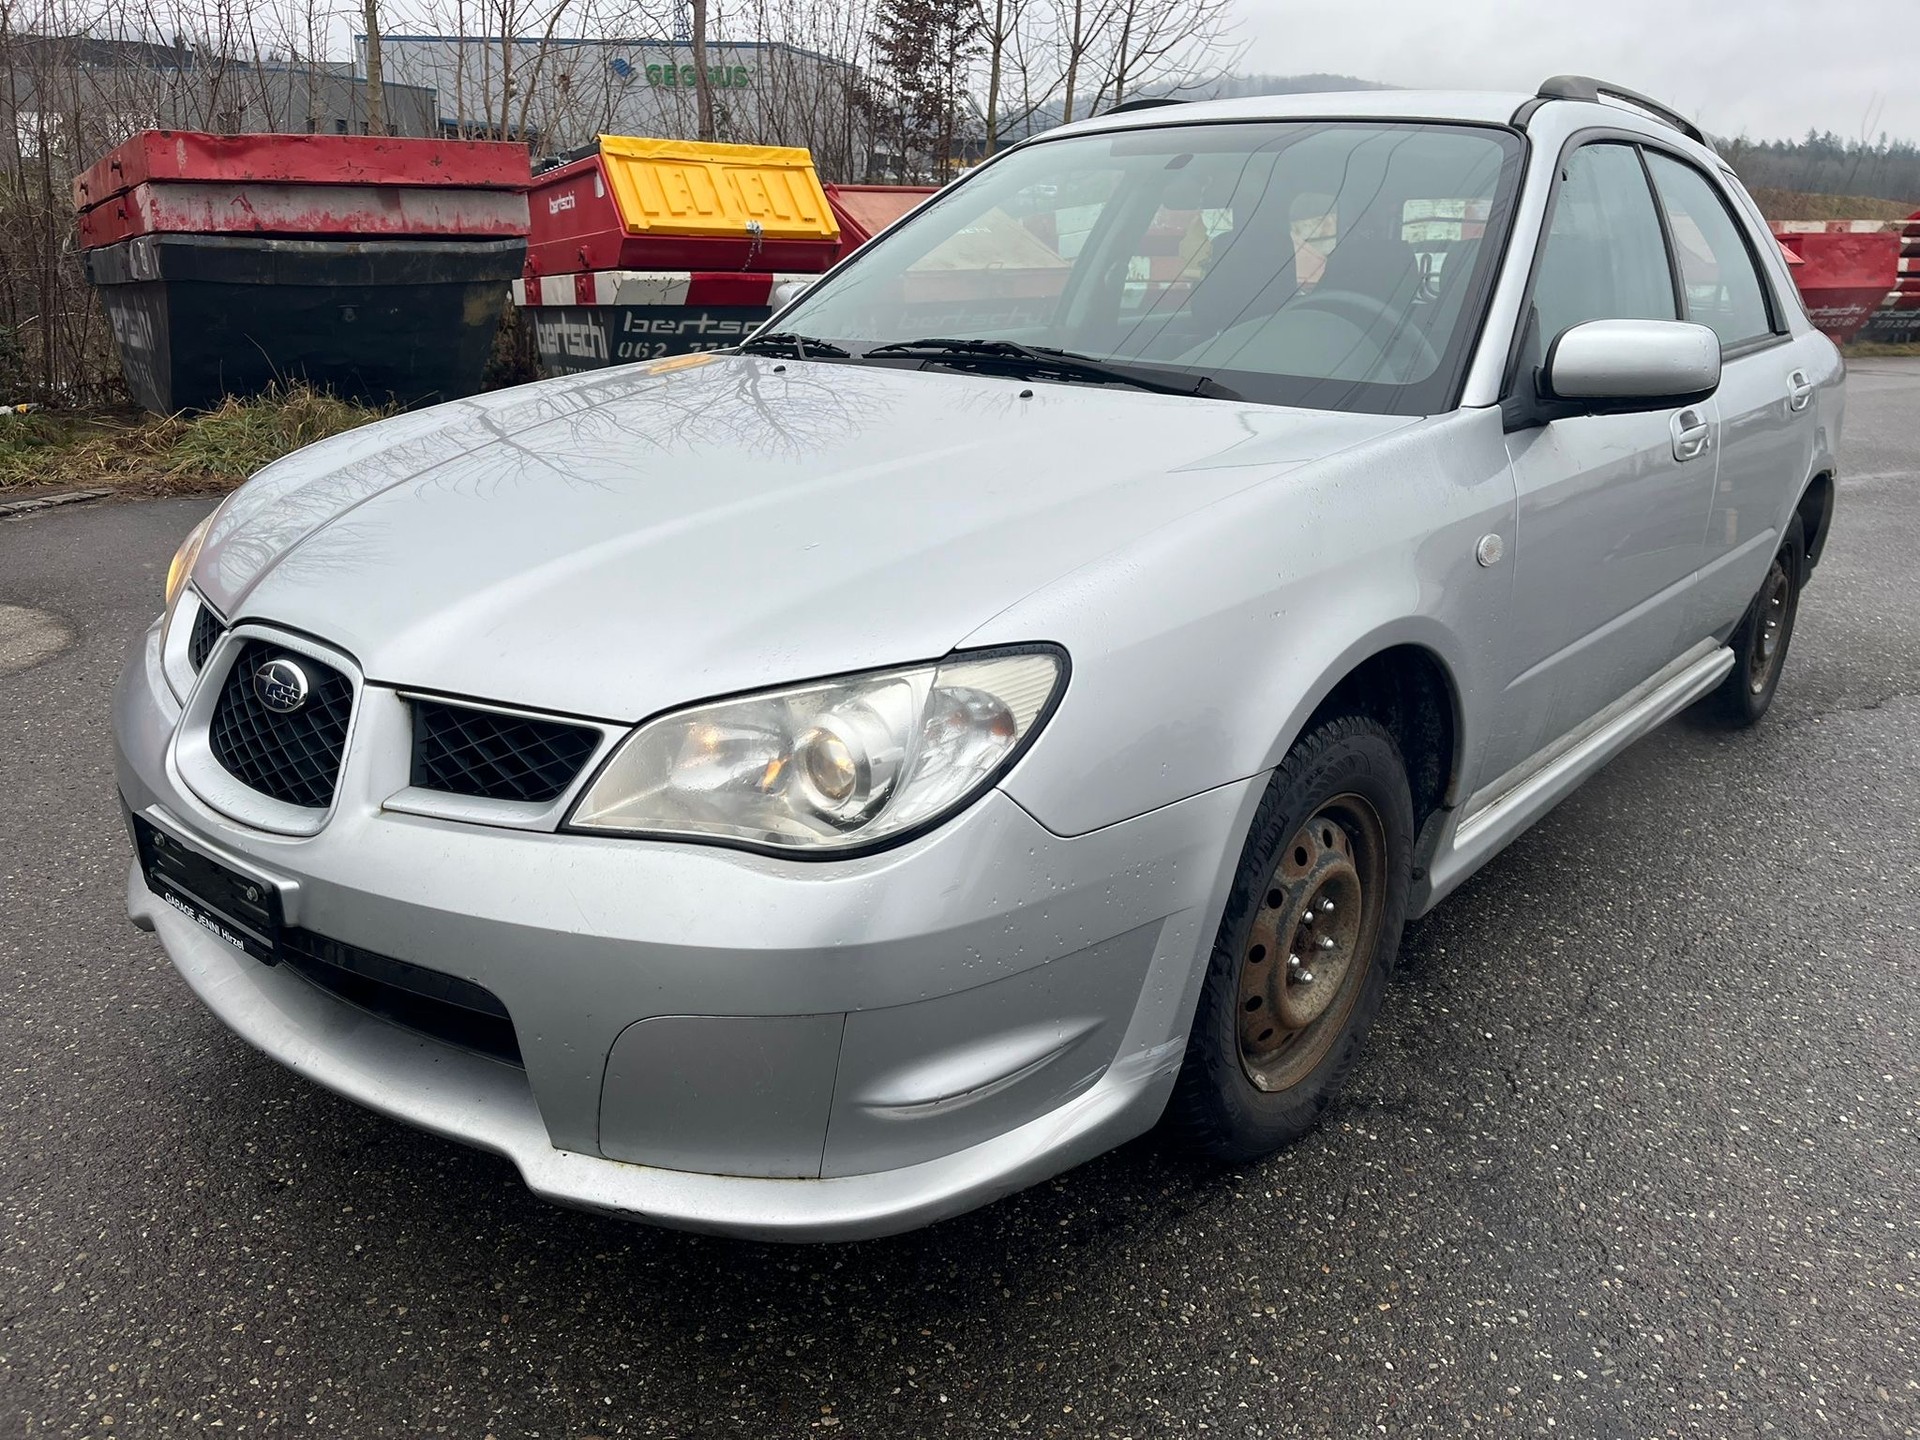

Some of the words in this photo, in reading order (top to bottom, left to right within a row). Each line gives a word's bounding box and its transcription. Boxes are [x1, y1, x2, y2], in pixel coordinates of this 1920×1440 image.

[534, 310, 609, 360] bertschi
[624, 311, 767, 334] bertsc
[165, 892, 196, 920] GARAGE
[197, 913, 220, 936] JENNI
[221, 929, 245, 951] Hirzel
